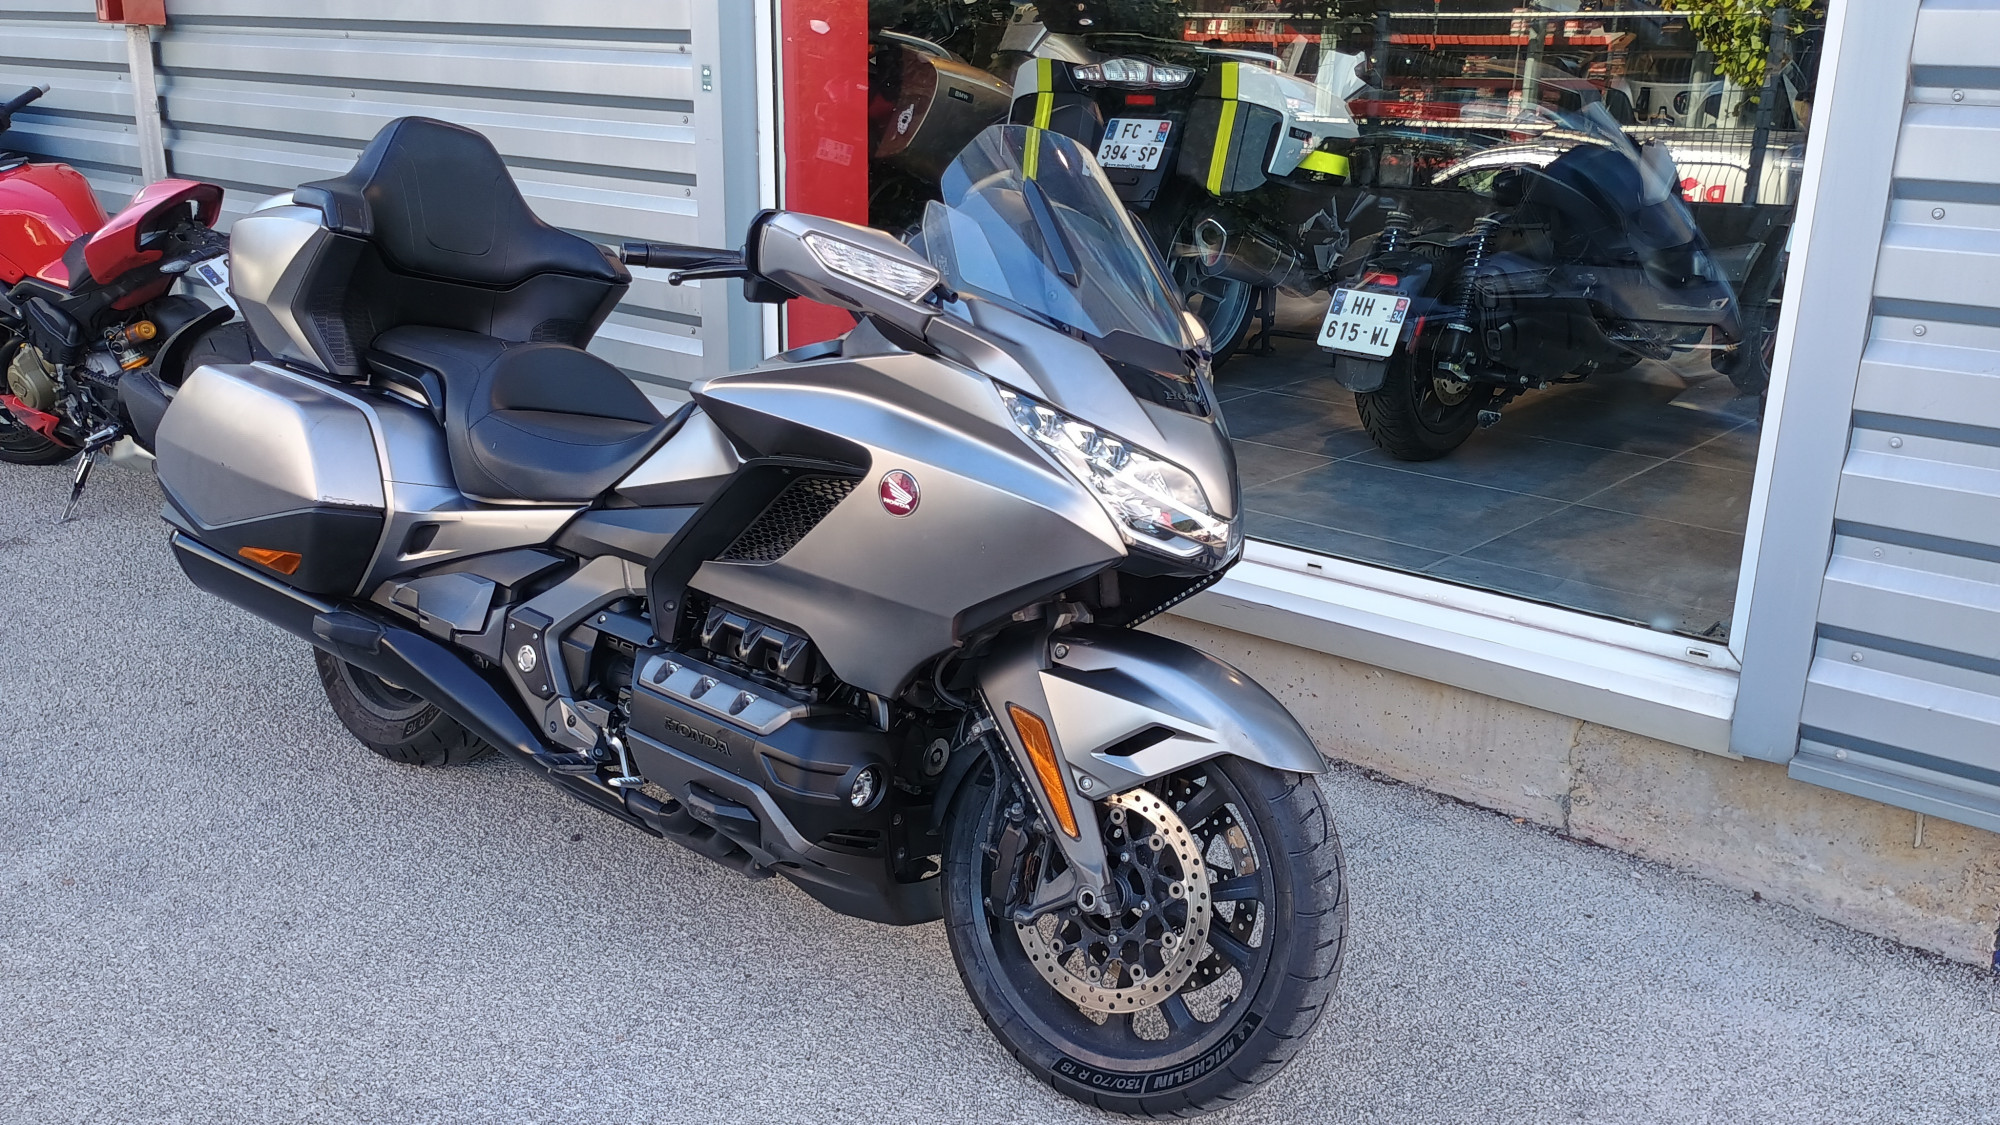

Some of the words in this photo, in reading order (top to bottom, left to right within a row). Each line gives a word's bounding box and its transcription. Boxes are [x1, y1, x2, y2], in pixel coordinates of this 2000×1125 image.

[954, 90, 968, 100] BMW
[1391, 311, 1403, 322] 34
[883, 497, 911, 510] HONDA
[664, 716, 733, 757] HONDA
[1060, 1062, 1077, 1075] 18
[1153, 1042, 1236, 1089] MICHELIN
[1092, 1074, 1142, 1090] 130/70
